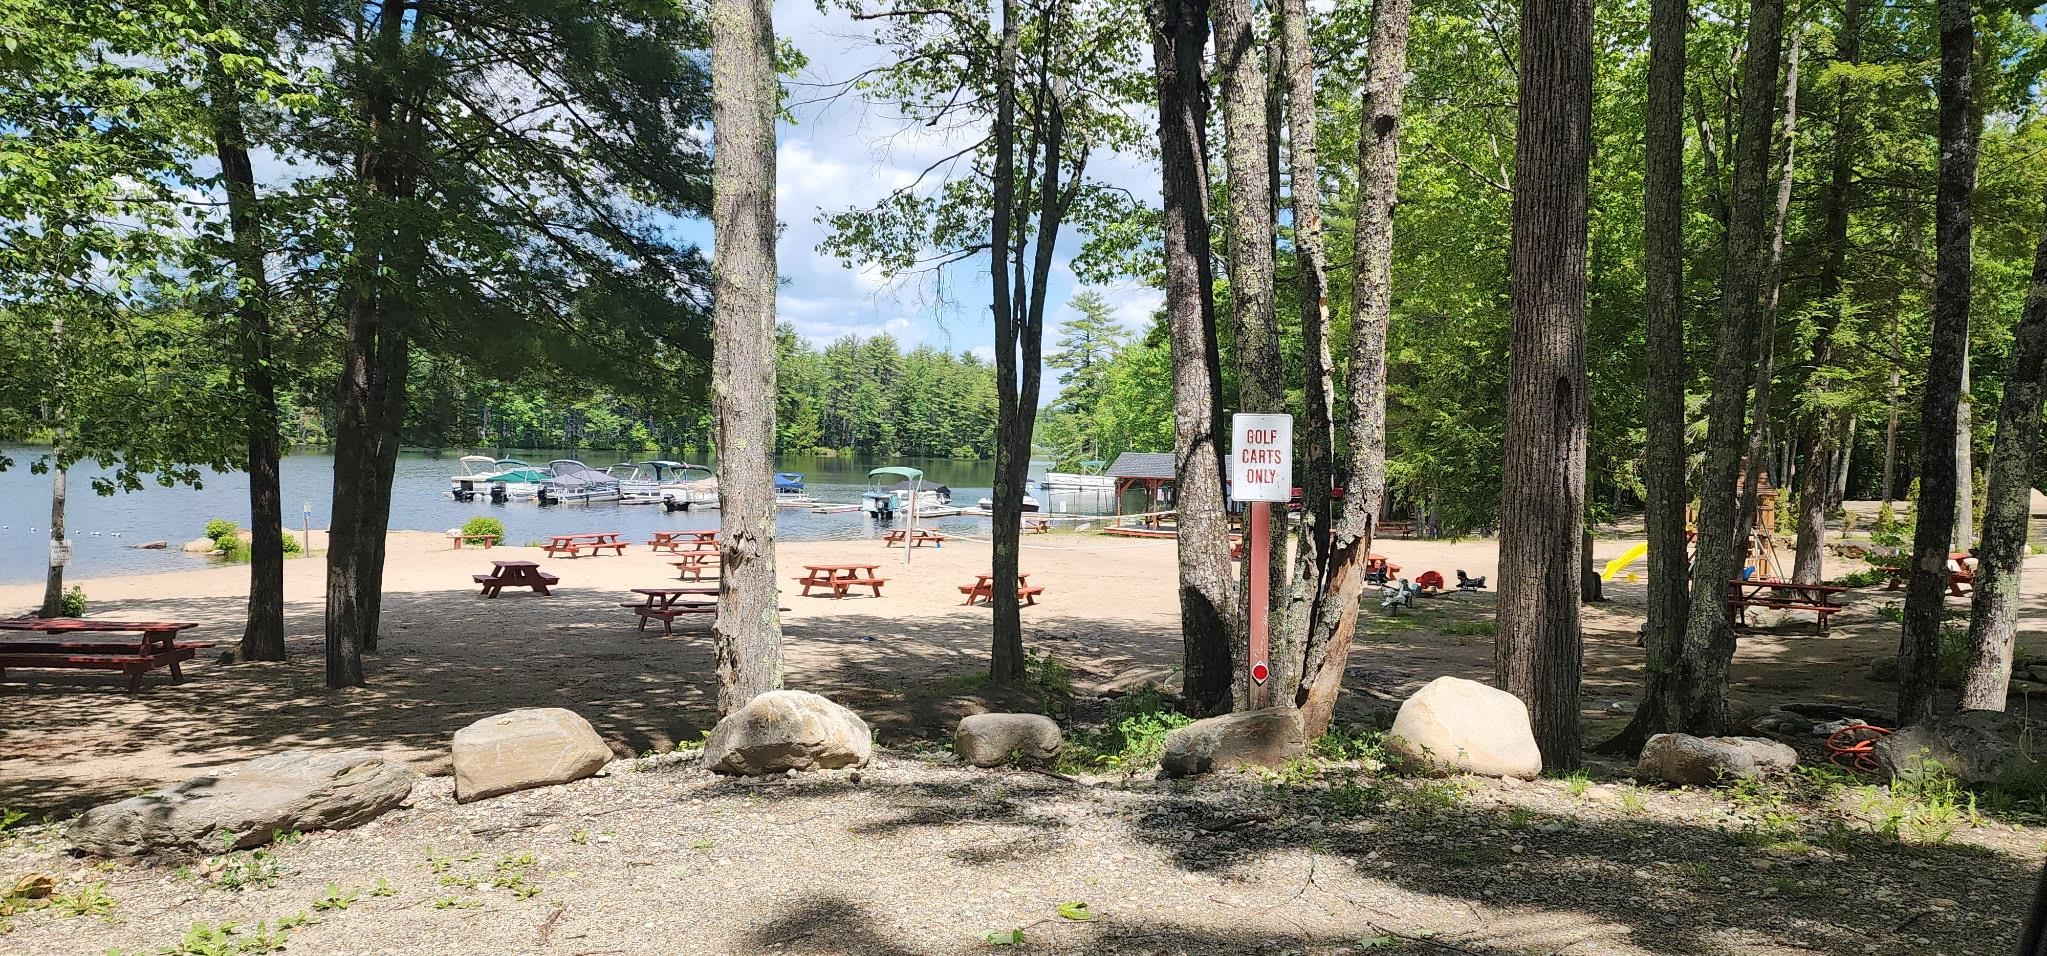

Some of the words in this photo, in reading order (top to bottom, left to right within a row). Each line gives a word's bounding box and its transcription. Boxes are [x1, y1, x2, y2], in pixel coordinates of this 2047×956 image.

[1247, 429, 1277, 444] GOLF
[1242, 449, 1281, 464] CARTS
[1247, 468, 1276, 484] ONLY
